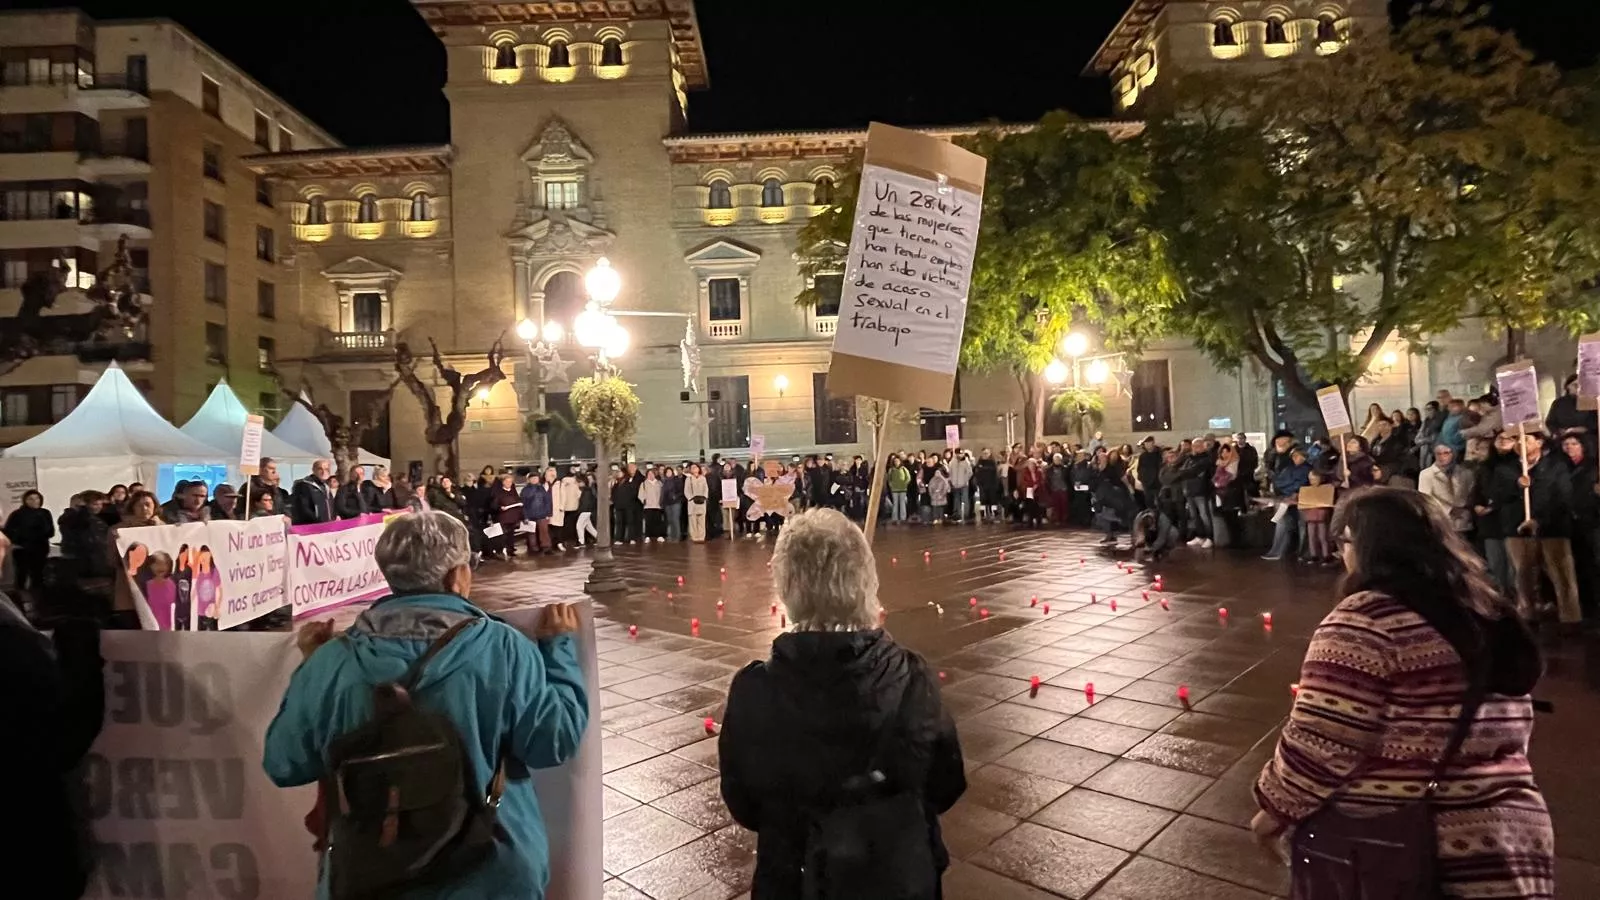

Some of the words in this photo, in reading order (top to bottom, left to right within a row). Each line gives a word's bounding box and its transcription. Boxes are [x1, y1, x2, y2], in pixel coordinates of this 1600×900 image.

[875, 181, 897, 203] Un
[869, 204, 889, 218] de
[894, 207, 912, 222] las
[917, 216, 966, 236] mujeres
[865, 238, 887, 253] han
[867, 224, 892, 241] que
[900, 225, 938, 246] tienen
[944, 241, 953, 249] o
[861, 254, 883, 270] han
[889, 260, 916, 276] sido
[854, 274, 875, 289] de
[915, 306, 931, 316] en
[936, 304, 949, 319] el
[228, 531, 244, 552] Ni
[324, 538, 351, 563] MÁS
[229, 562, 256, 582] vivas
[259, 561, 265, 583] y
[294, 578, 344, 606] CONTRA
[346, 571, 369, 592] LAS
[228, 595, 247, 614] nos
